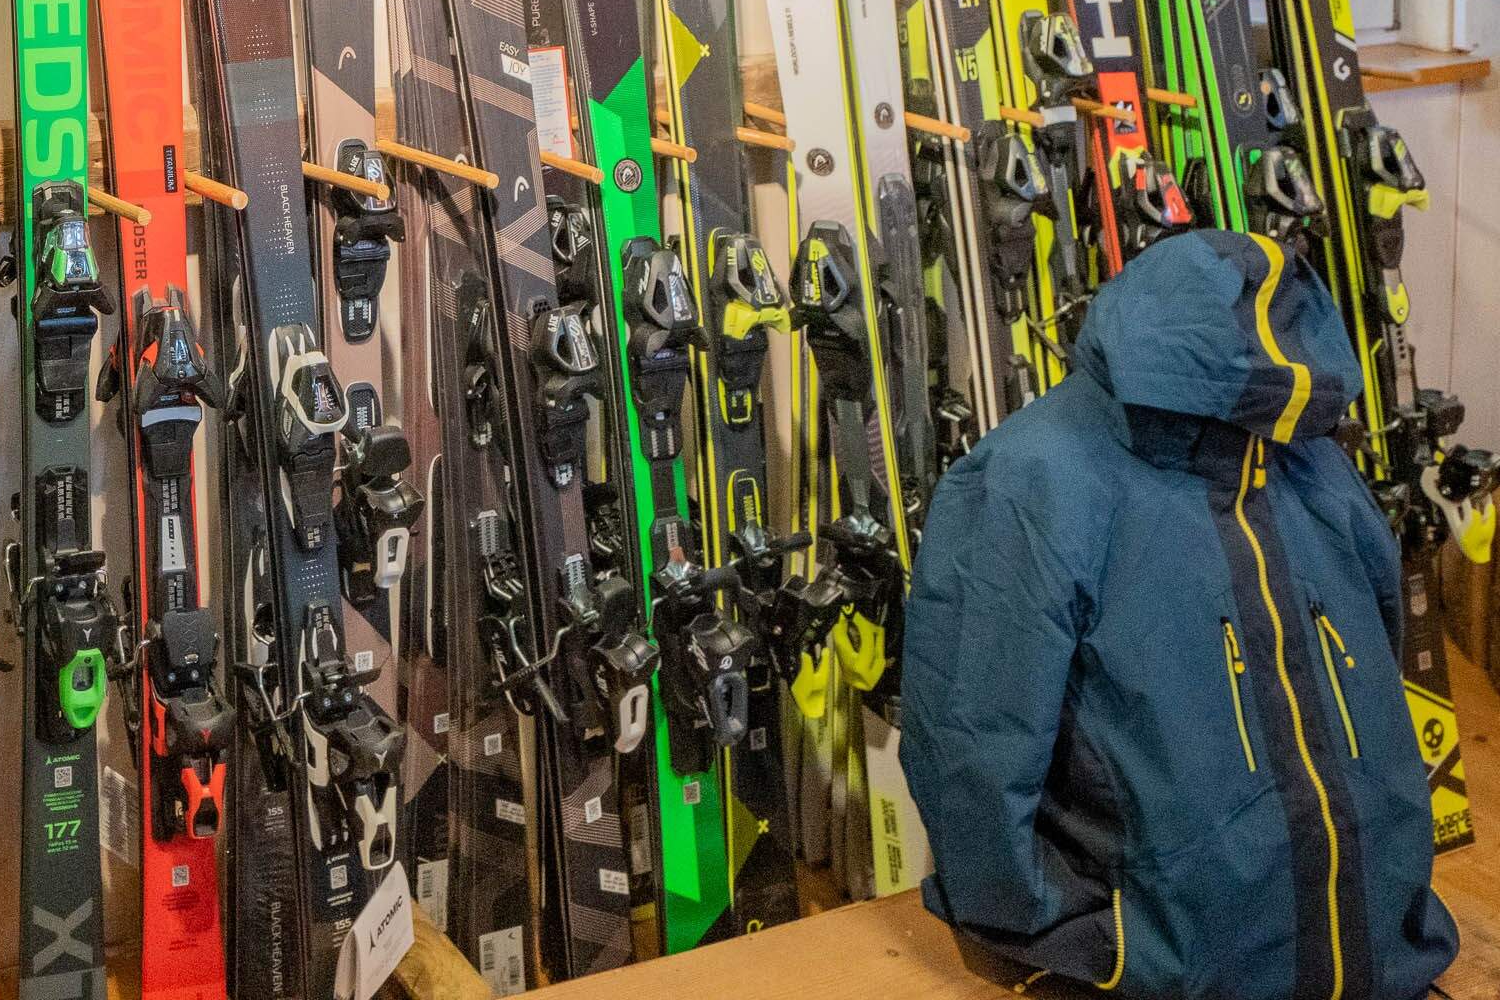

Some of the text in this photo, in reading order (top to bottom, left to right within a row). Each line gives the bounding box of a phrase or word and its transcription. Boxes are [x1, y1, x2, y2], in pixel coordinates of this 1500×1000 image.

[588, 1, 598, 37] V-SHAPE
[499, 41, 520, 57] EASY
[956, 53, 978, 82] V5
[164, 148, 176, 192] TITANIUM
[280, 184, 296, 255] BLACK HEAVEN
[132, 220, 148, 280] DSTER
[53, 754, 81, 763] ATOMIC
[267, 806, 284, 816] 155
[44, 819, 82, 840] 177
[376, 895, 403, 939] ATOMIC
[270, 901, 283, 993] BLACK HEAVEN
